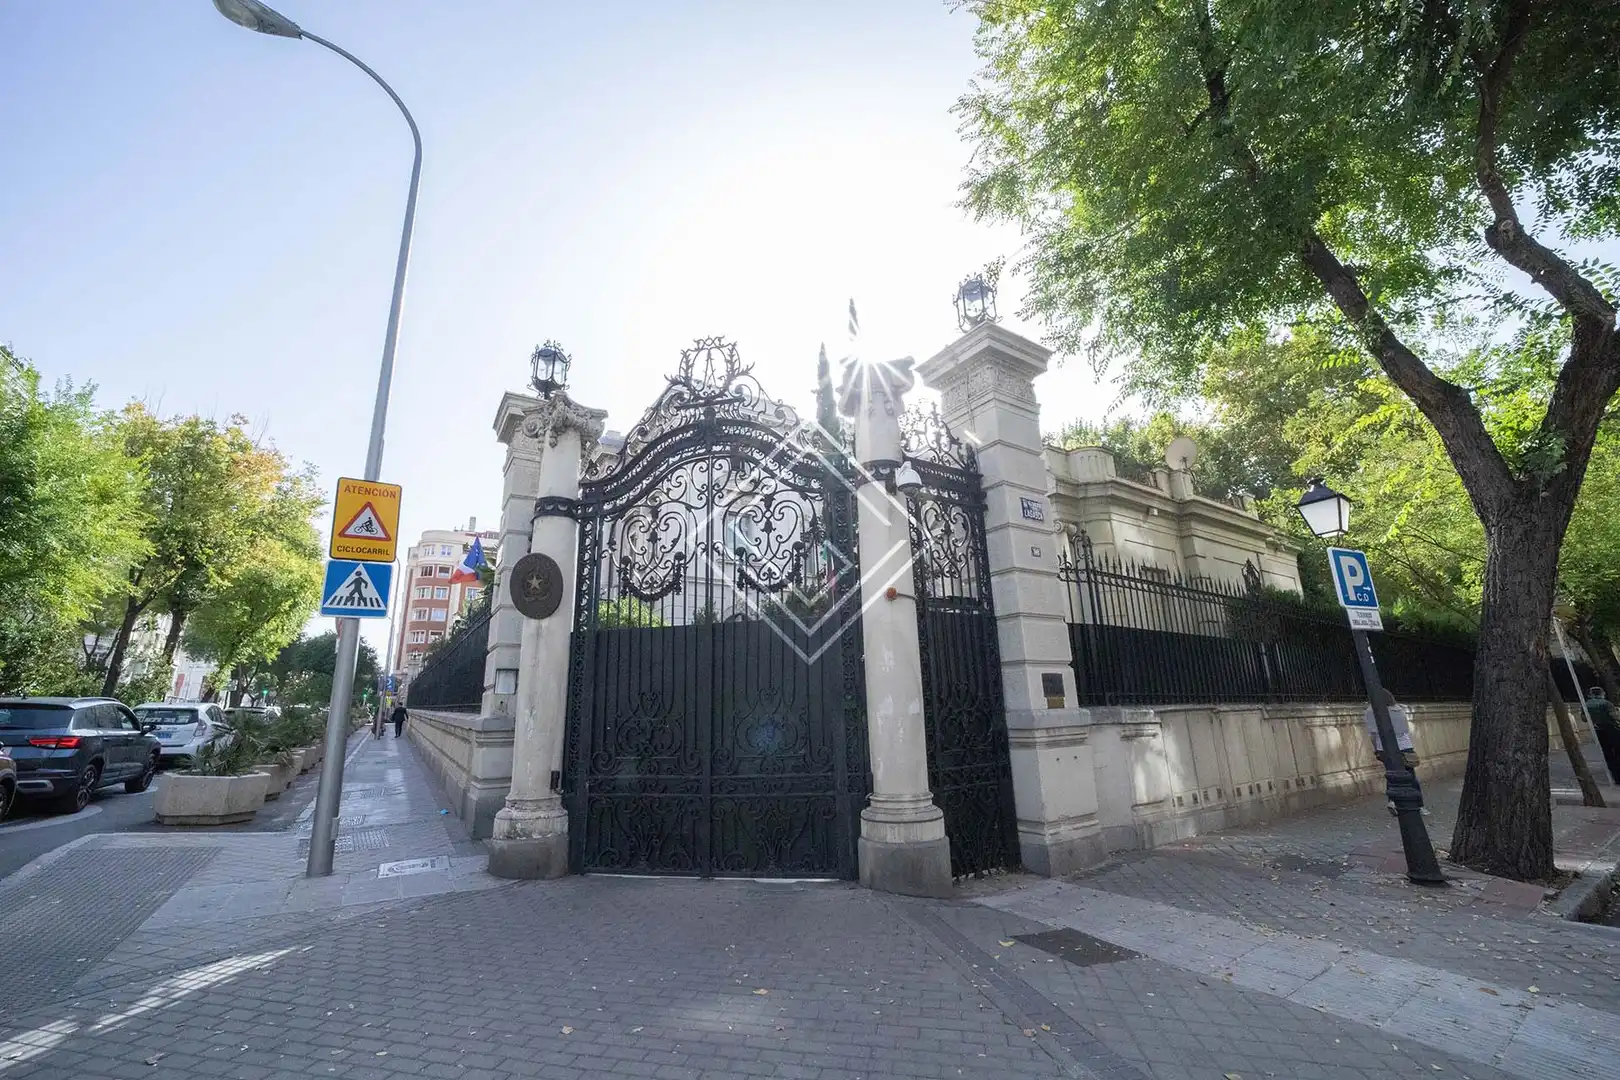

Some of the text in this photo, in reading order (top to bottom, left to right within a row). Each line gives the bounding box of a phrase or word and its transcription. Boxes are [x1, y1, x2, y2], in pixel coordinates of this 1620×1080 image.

[344, 485, 396, 498] ATENCIÓN
[337, 545, 390, 556] CICLOCARRIL
[1339, 556, 1364, 600] P
